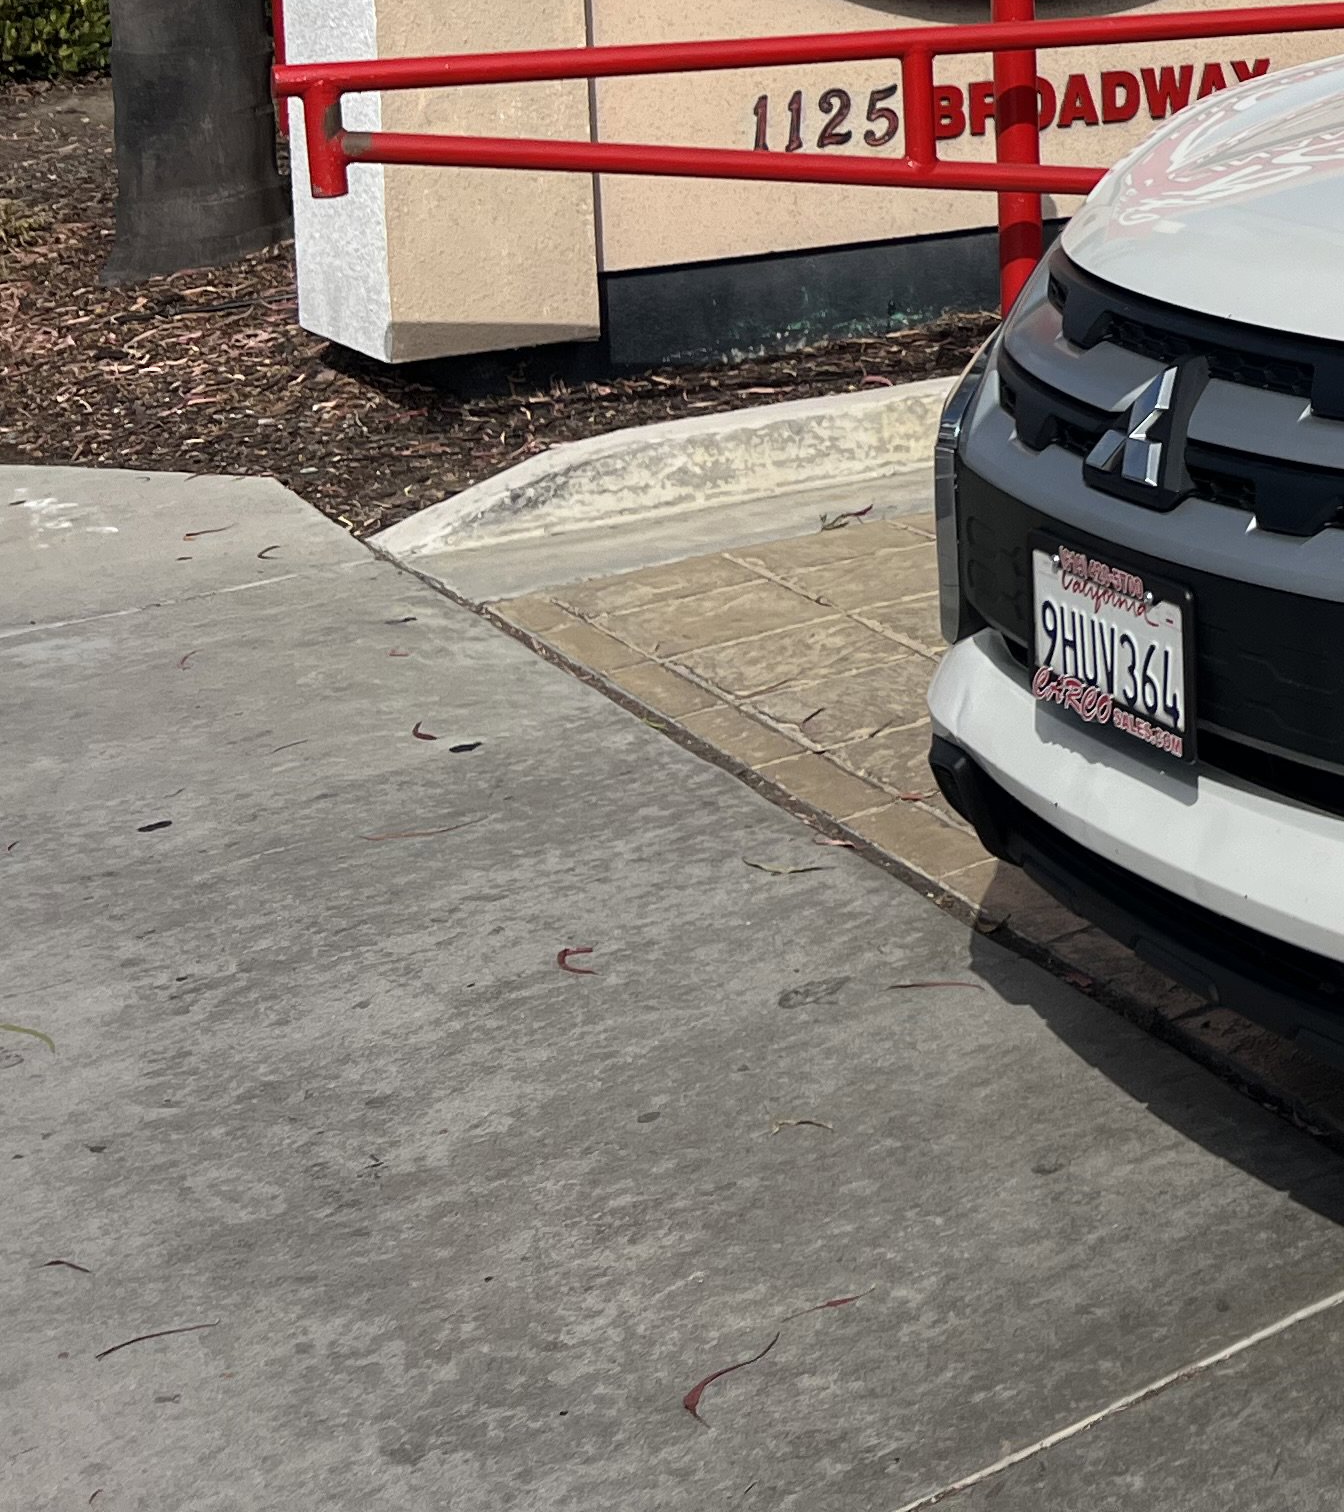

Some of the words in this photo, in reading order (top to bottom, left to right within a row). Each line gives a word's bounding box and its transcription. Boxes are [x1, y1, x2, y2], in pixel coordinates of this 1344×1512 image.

[752, 83, 898, 152] 1125
[1061, 568, 1159, 627] California
[1032, 665, 1114, 724] CARCO
[1042, 600, 1180, 728] 9HUV364
